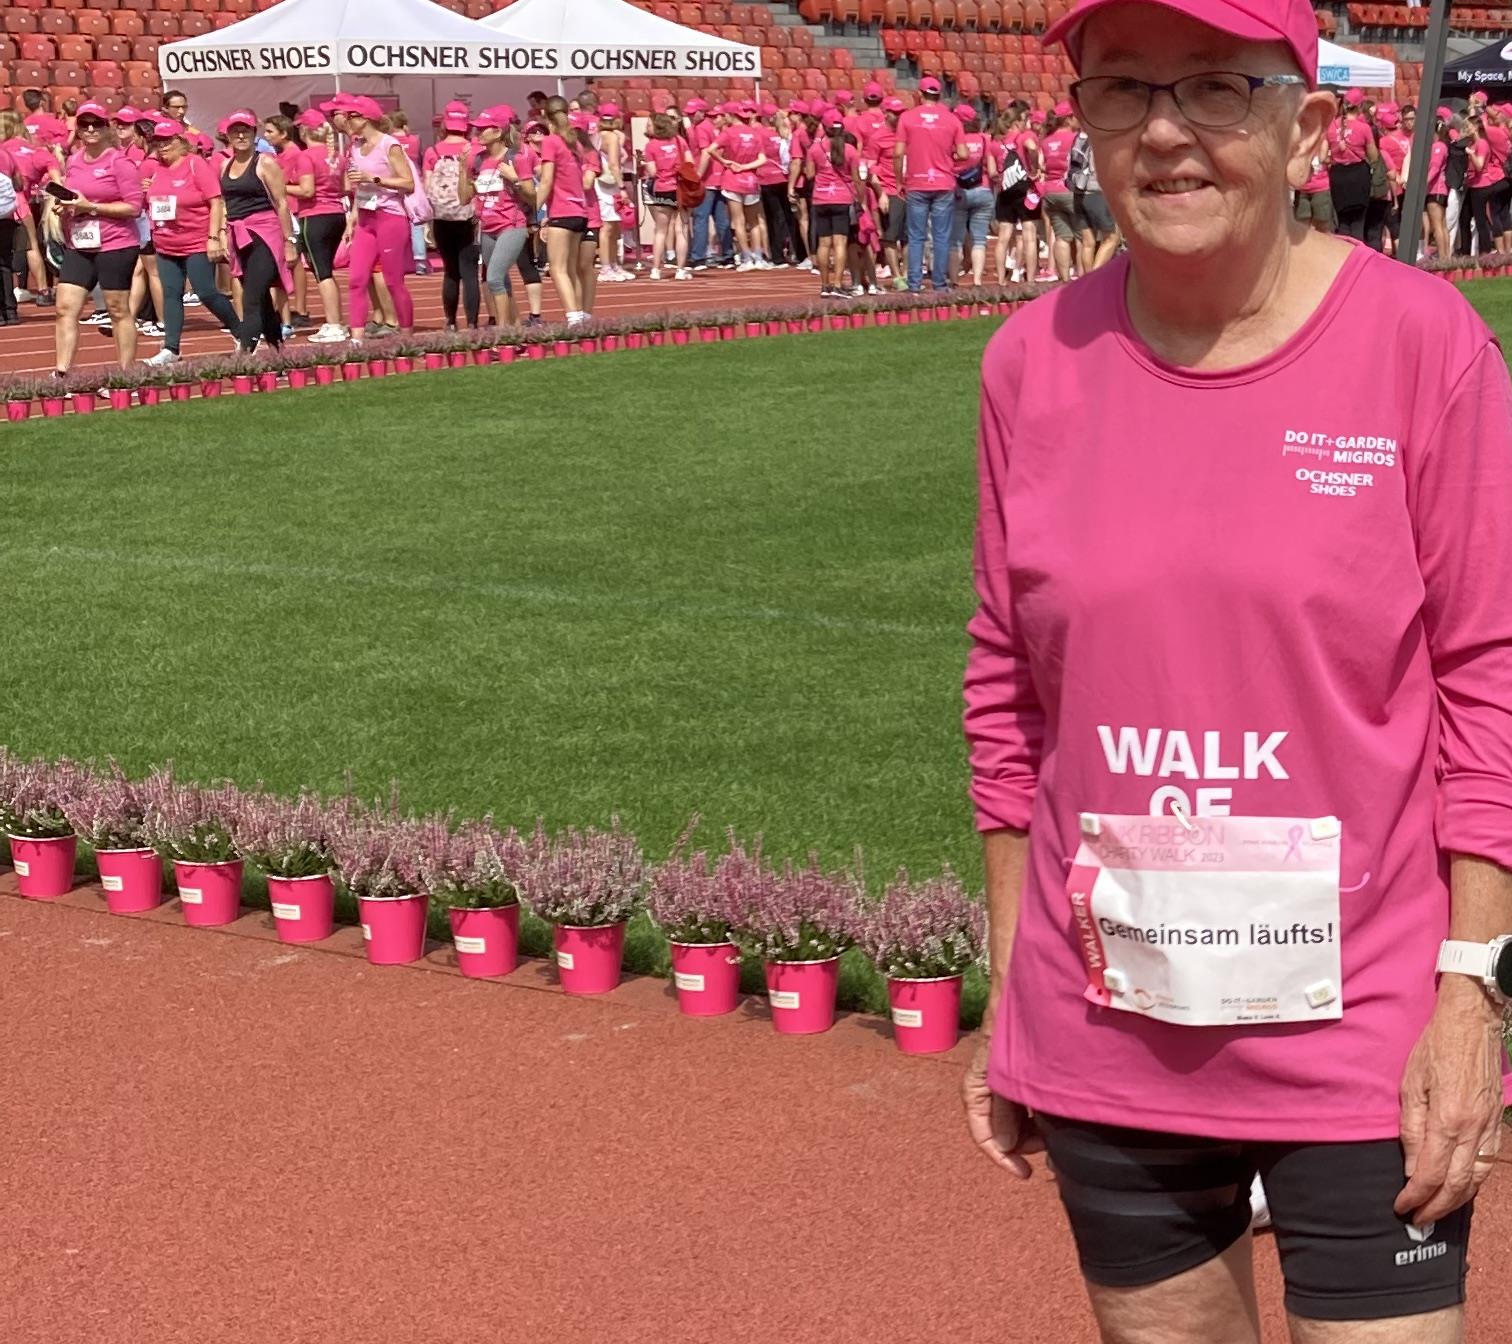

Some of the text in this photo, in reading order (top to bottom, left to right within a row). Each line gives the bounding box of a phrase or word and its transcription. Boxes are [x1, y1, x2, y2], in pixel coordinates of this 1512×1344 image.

[165, 45, 331, 73] OCHSNER SHOES
[346, 44, 558, 70] OCHSNER SHOES
[570, 49, 756, 72] OCHSNER SHOES
[1457, 71, 1472, 83] My
[1284, 429, 1309, 444] DO
[1332, 450, 1395, 467] MIGROS
[1295, 468, 1374, 486] OCHSNER
[1309, 483, 1357, 497] SHOES
[1097, 725, 1289, 780] WALK
[1151, 848, 1196, 862] WALK
[1071, 892, 1102, 968] WALKER
[1099, 918, 1334, 946] Gemeinsam läufts!
[1395, 1240, 1447, 1266] erima
